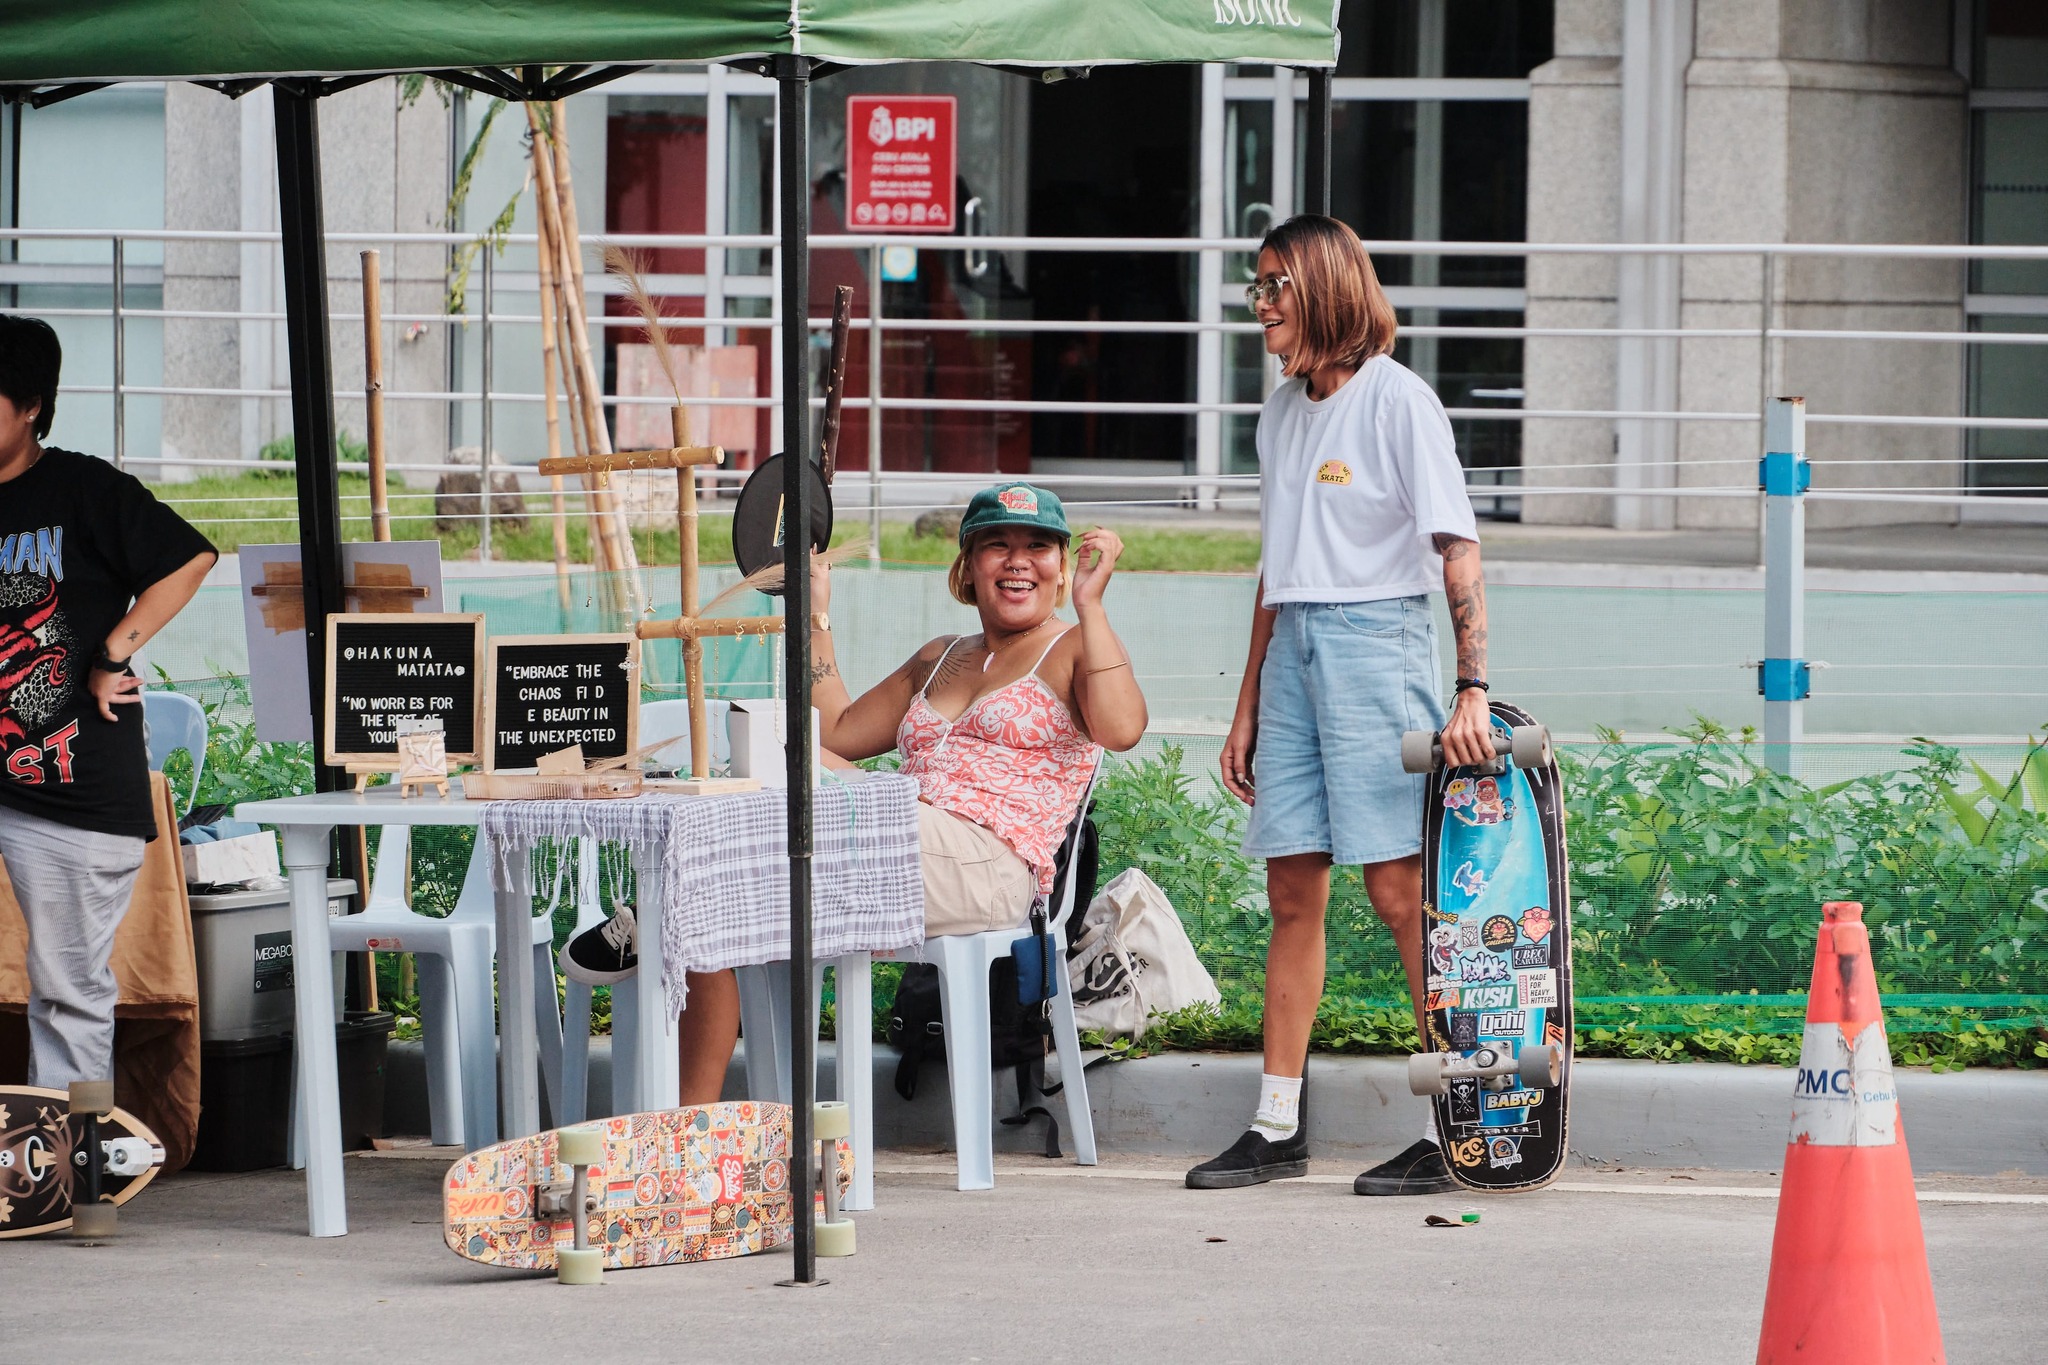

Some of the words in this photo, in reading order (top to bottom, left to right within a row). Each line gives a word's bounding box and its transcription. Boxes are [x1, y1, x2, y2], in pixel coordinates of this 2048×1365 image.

[895, 117, 935, 141] BPI
[1320, 473, 1345, 483] SKATE
[576, 663, 602, 679] THE
[519, 687, 561, 701] CHAOS
[430, 697, 454, 711] FOR
[360, 713, 384, 727] THE
[543, 707, 591, 722] BEAUTY
[594, 707, 609, 721] IN
[498, 731, 523, 745] THE
[529, 728, 616, 744] UNEXPECTED
[1485, 937, 1515, 947] COLLECTIVE
[1514, 948, 1545, 960] UBEC
[1515, 957, 1546, 965] CARTEL
[1530, 973, 1547, 981] MADE
[1530, 981, 1542, 989] FOR
[1462, 986, 1514, 1009] KUSH
[1530, 989, 1550, 997] HEAVY
[1863, 1091, 1890, 1102] Cebu
